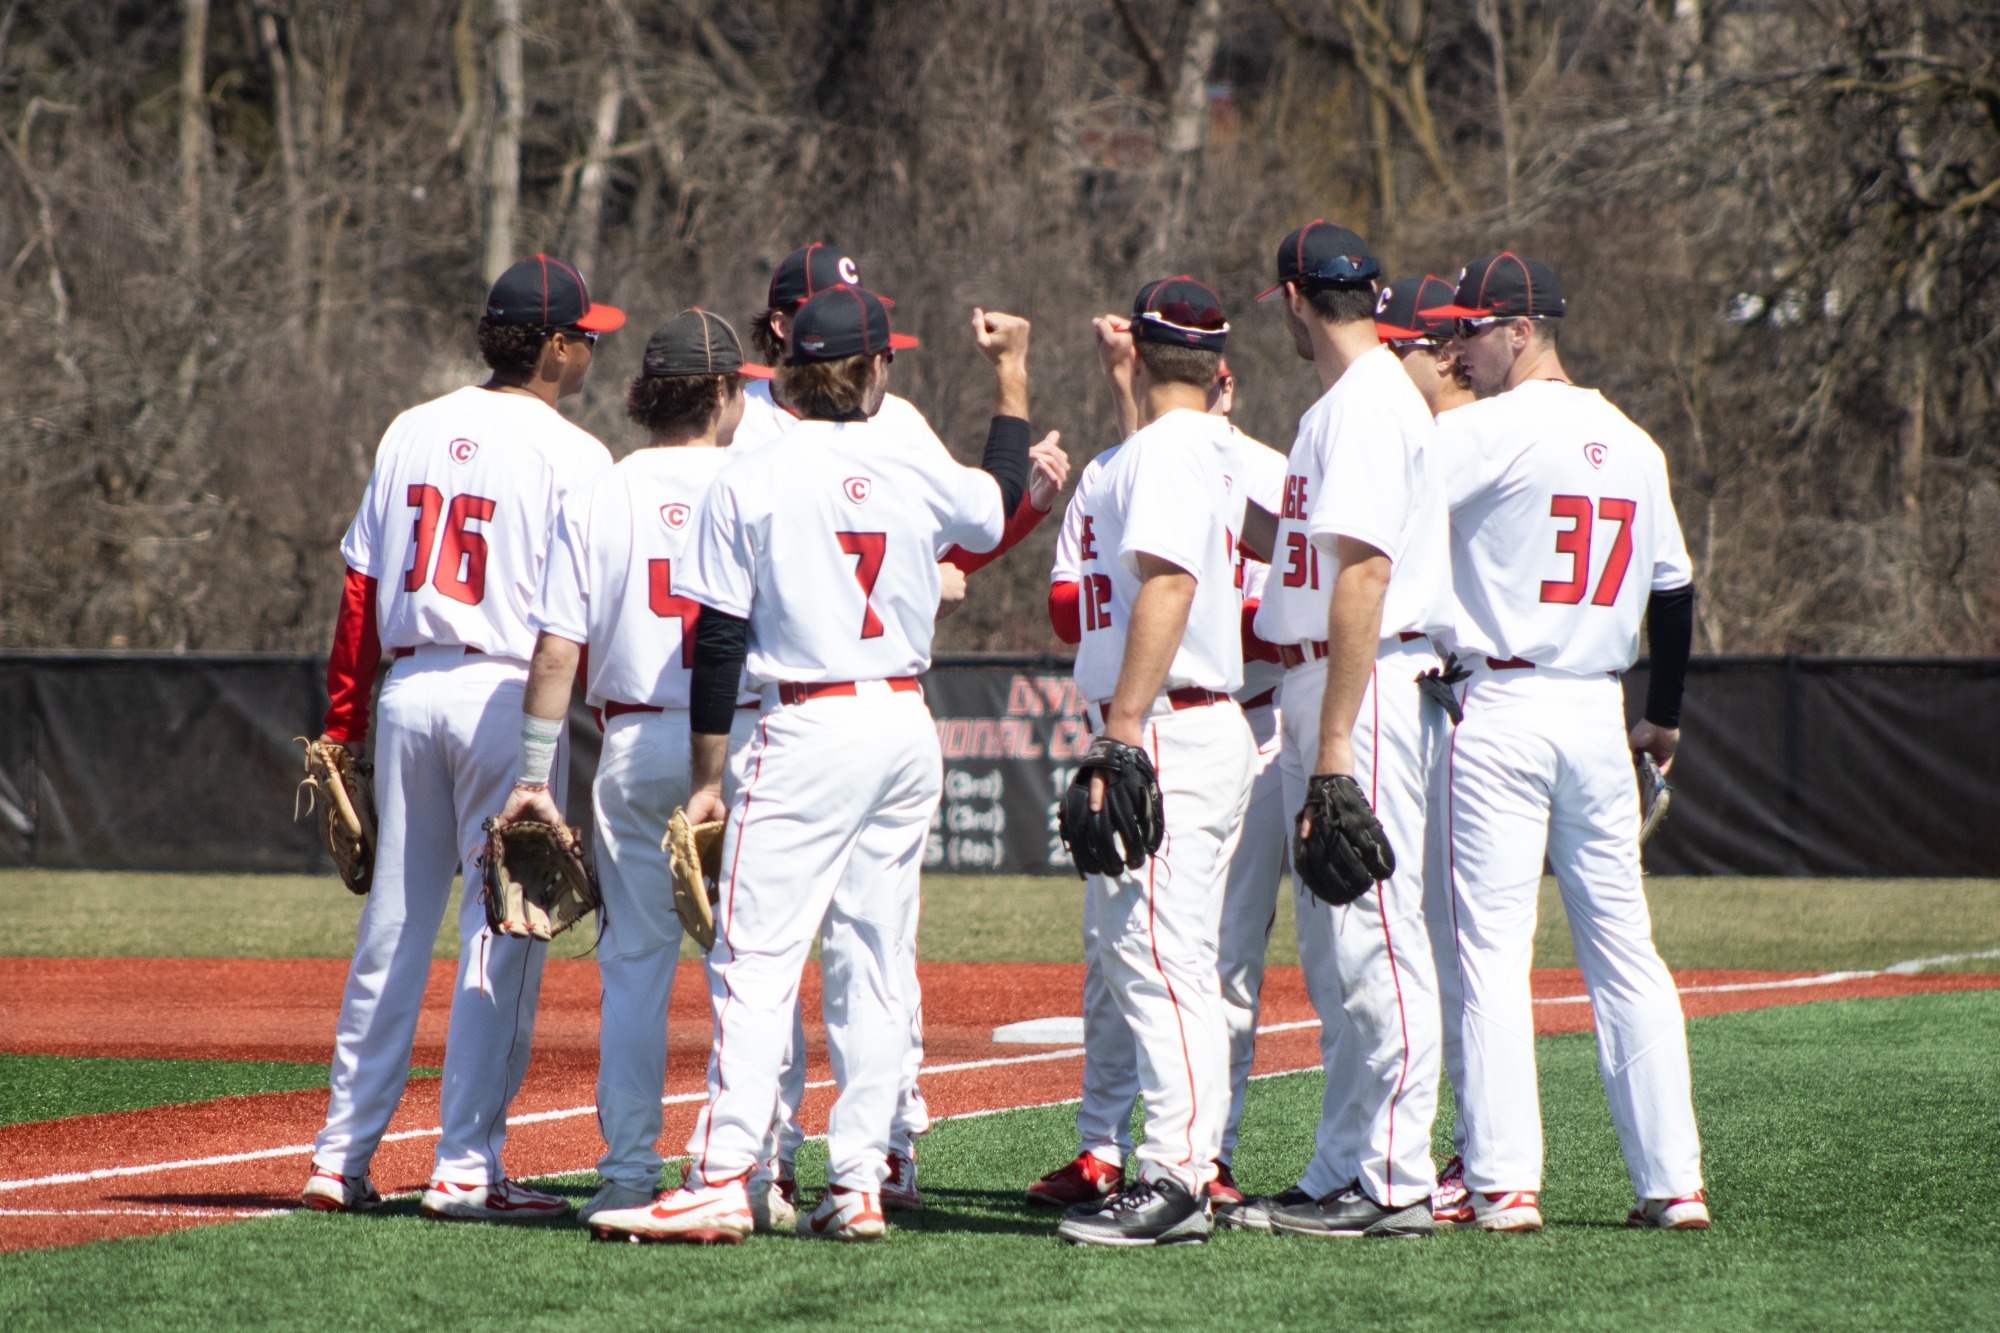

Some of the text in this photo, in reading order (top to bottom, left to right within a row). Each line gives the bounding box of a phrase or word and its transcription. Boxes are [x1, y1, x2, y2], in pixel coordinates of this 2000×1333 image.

[838, 256, 859, 285] C
[1376, 287, 1392, 314] C
[454, 443, 472, 461] C
[1590, 447, 1603, 465] C
[851, 482, 866, 500] C
[668, 508, 684, 526] C
[404, 483, 497, 607] 36
[1081, 515, 1098, 561] E
[1539, 494, 1637, 607] 37
[1283, 531, 1319, 590] 31
[835, 531, 887, 640] 7
[1083, 573, 1112, 631] 12
[936, 718, 1043, 758] IONAL
